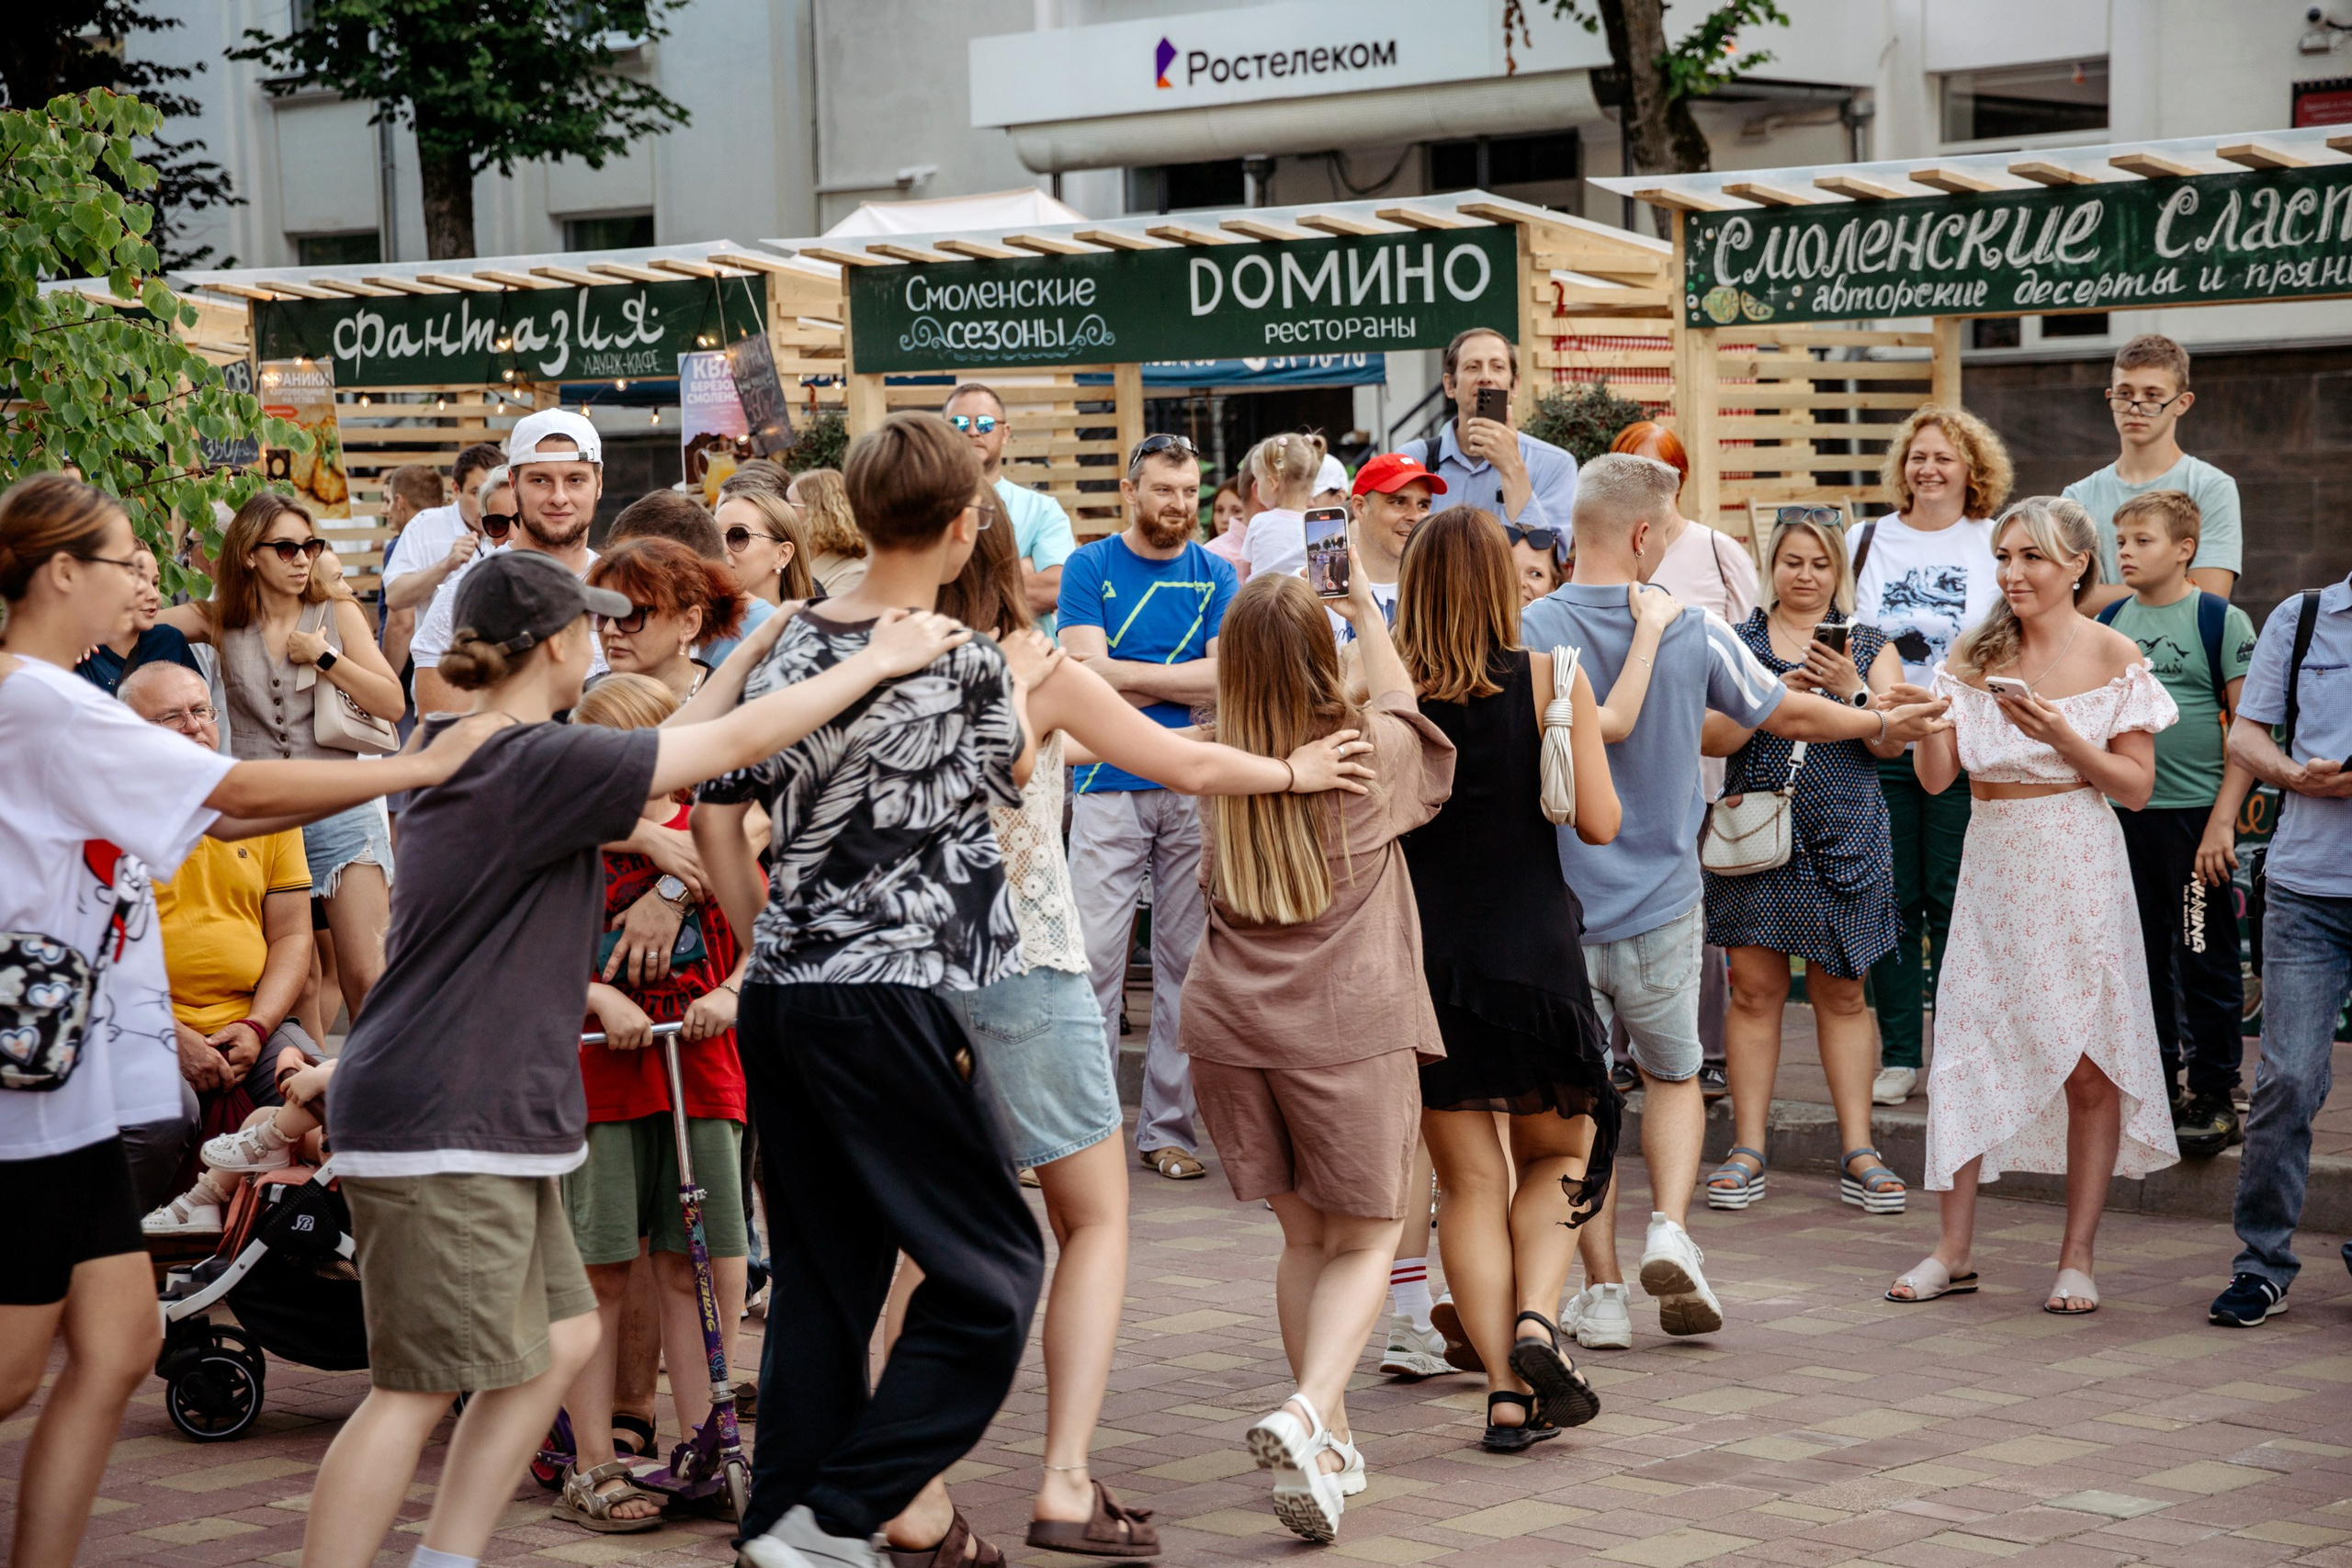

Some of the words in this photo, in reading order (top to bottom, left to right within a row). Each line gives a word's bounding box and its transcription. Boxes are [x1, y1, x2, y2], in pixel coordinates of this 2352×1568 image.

[1188, 39, 1396, 85] Ростелеком
[1713, 197, 2104, 287] Смоленские
[905, 275, 1097, 311] Смоленские
[1812, 274, 1988, 316] авторские
[2013, 267, 2188, 307] десерты
[2199, 265, 2226, 292] и
[946, 318, 1066, 350] сезоны
[1264, 316, 1417, 344] рестораны
[692, 358, 733, 380] КВА
[686, 392, 741, 405] СМОЛЕНС
